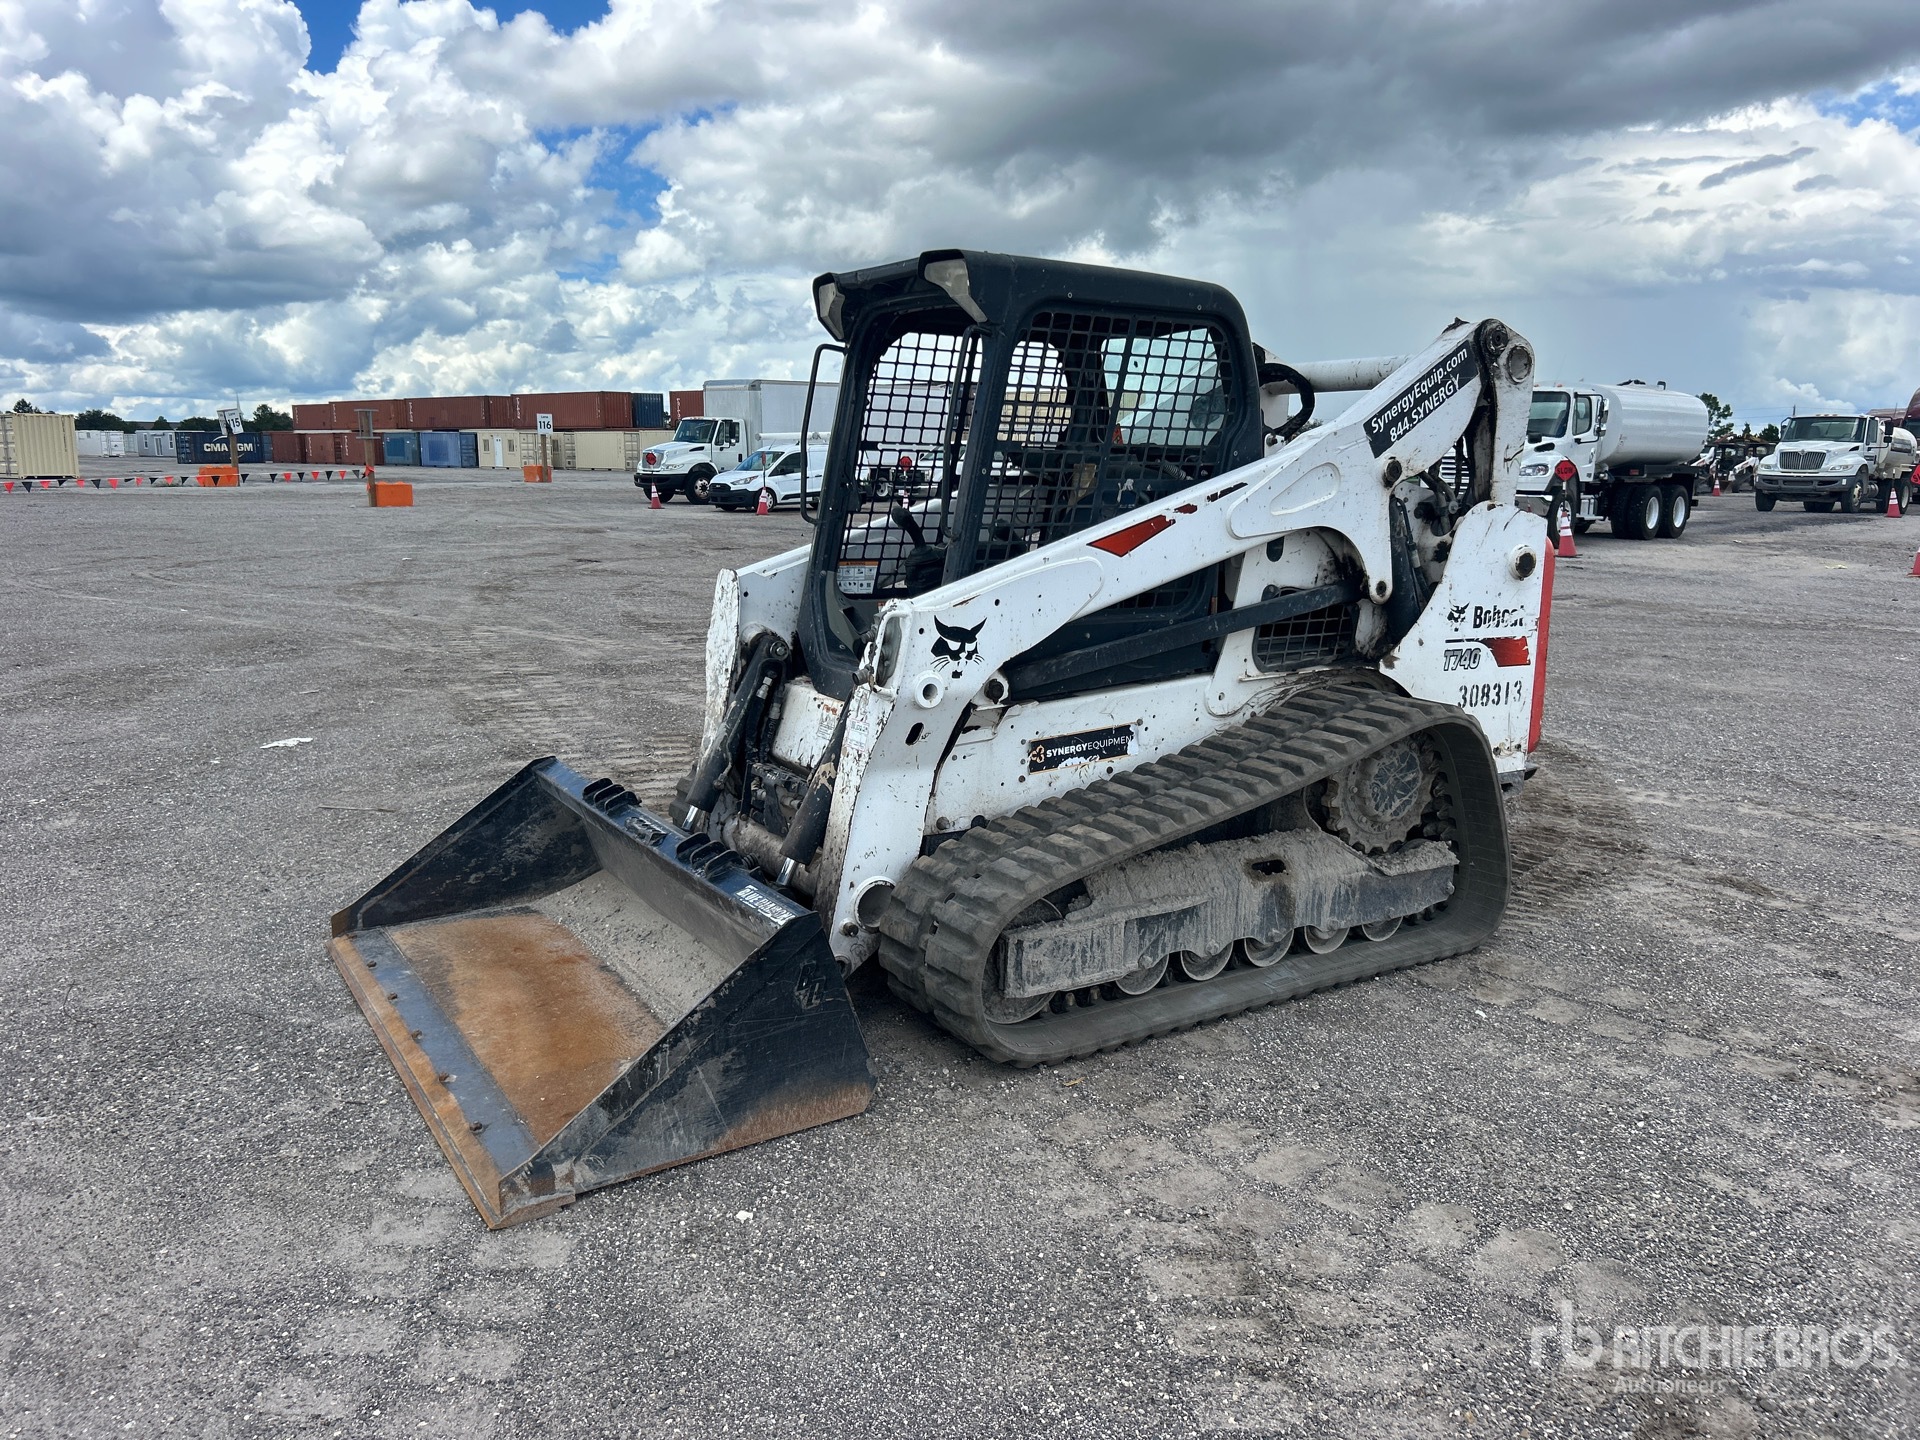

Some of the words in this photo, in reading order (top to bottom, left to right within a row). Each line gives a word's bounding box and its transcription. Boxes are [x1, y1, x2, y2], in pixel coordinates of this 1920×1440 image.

[1371, 348, 1468, 433] SynergyEquip.com
[1389, 373, 1460, 442] 844.SYNERGY
[538, 420, 552, 430] 116
[203, 443, 229, 452] CMA
[236, 443, 254, 452] GM
[1443, 647, 1482, 672] T740
[1457, 680, 1523, 709] 308313
[1046, 734, 1134, 759] SYNERGYEQUIPMEN
